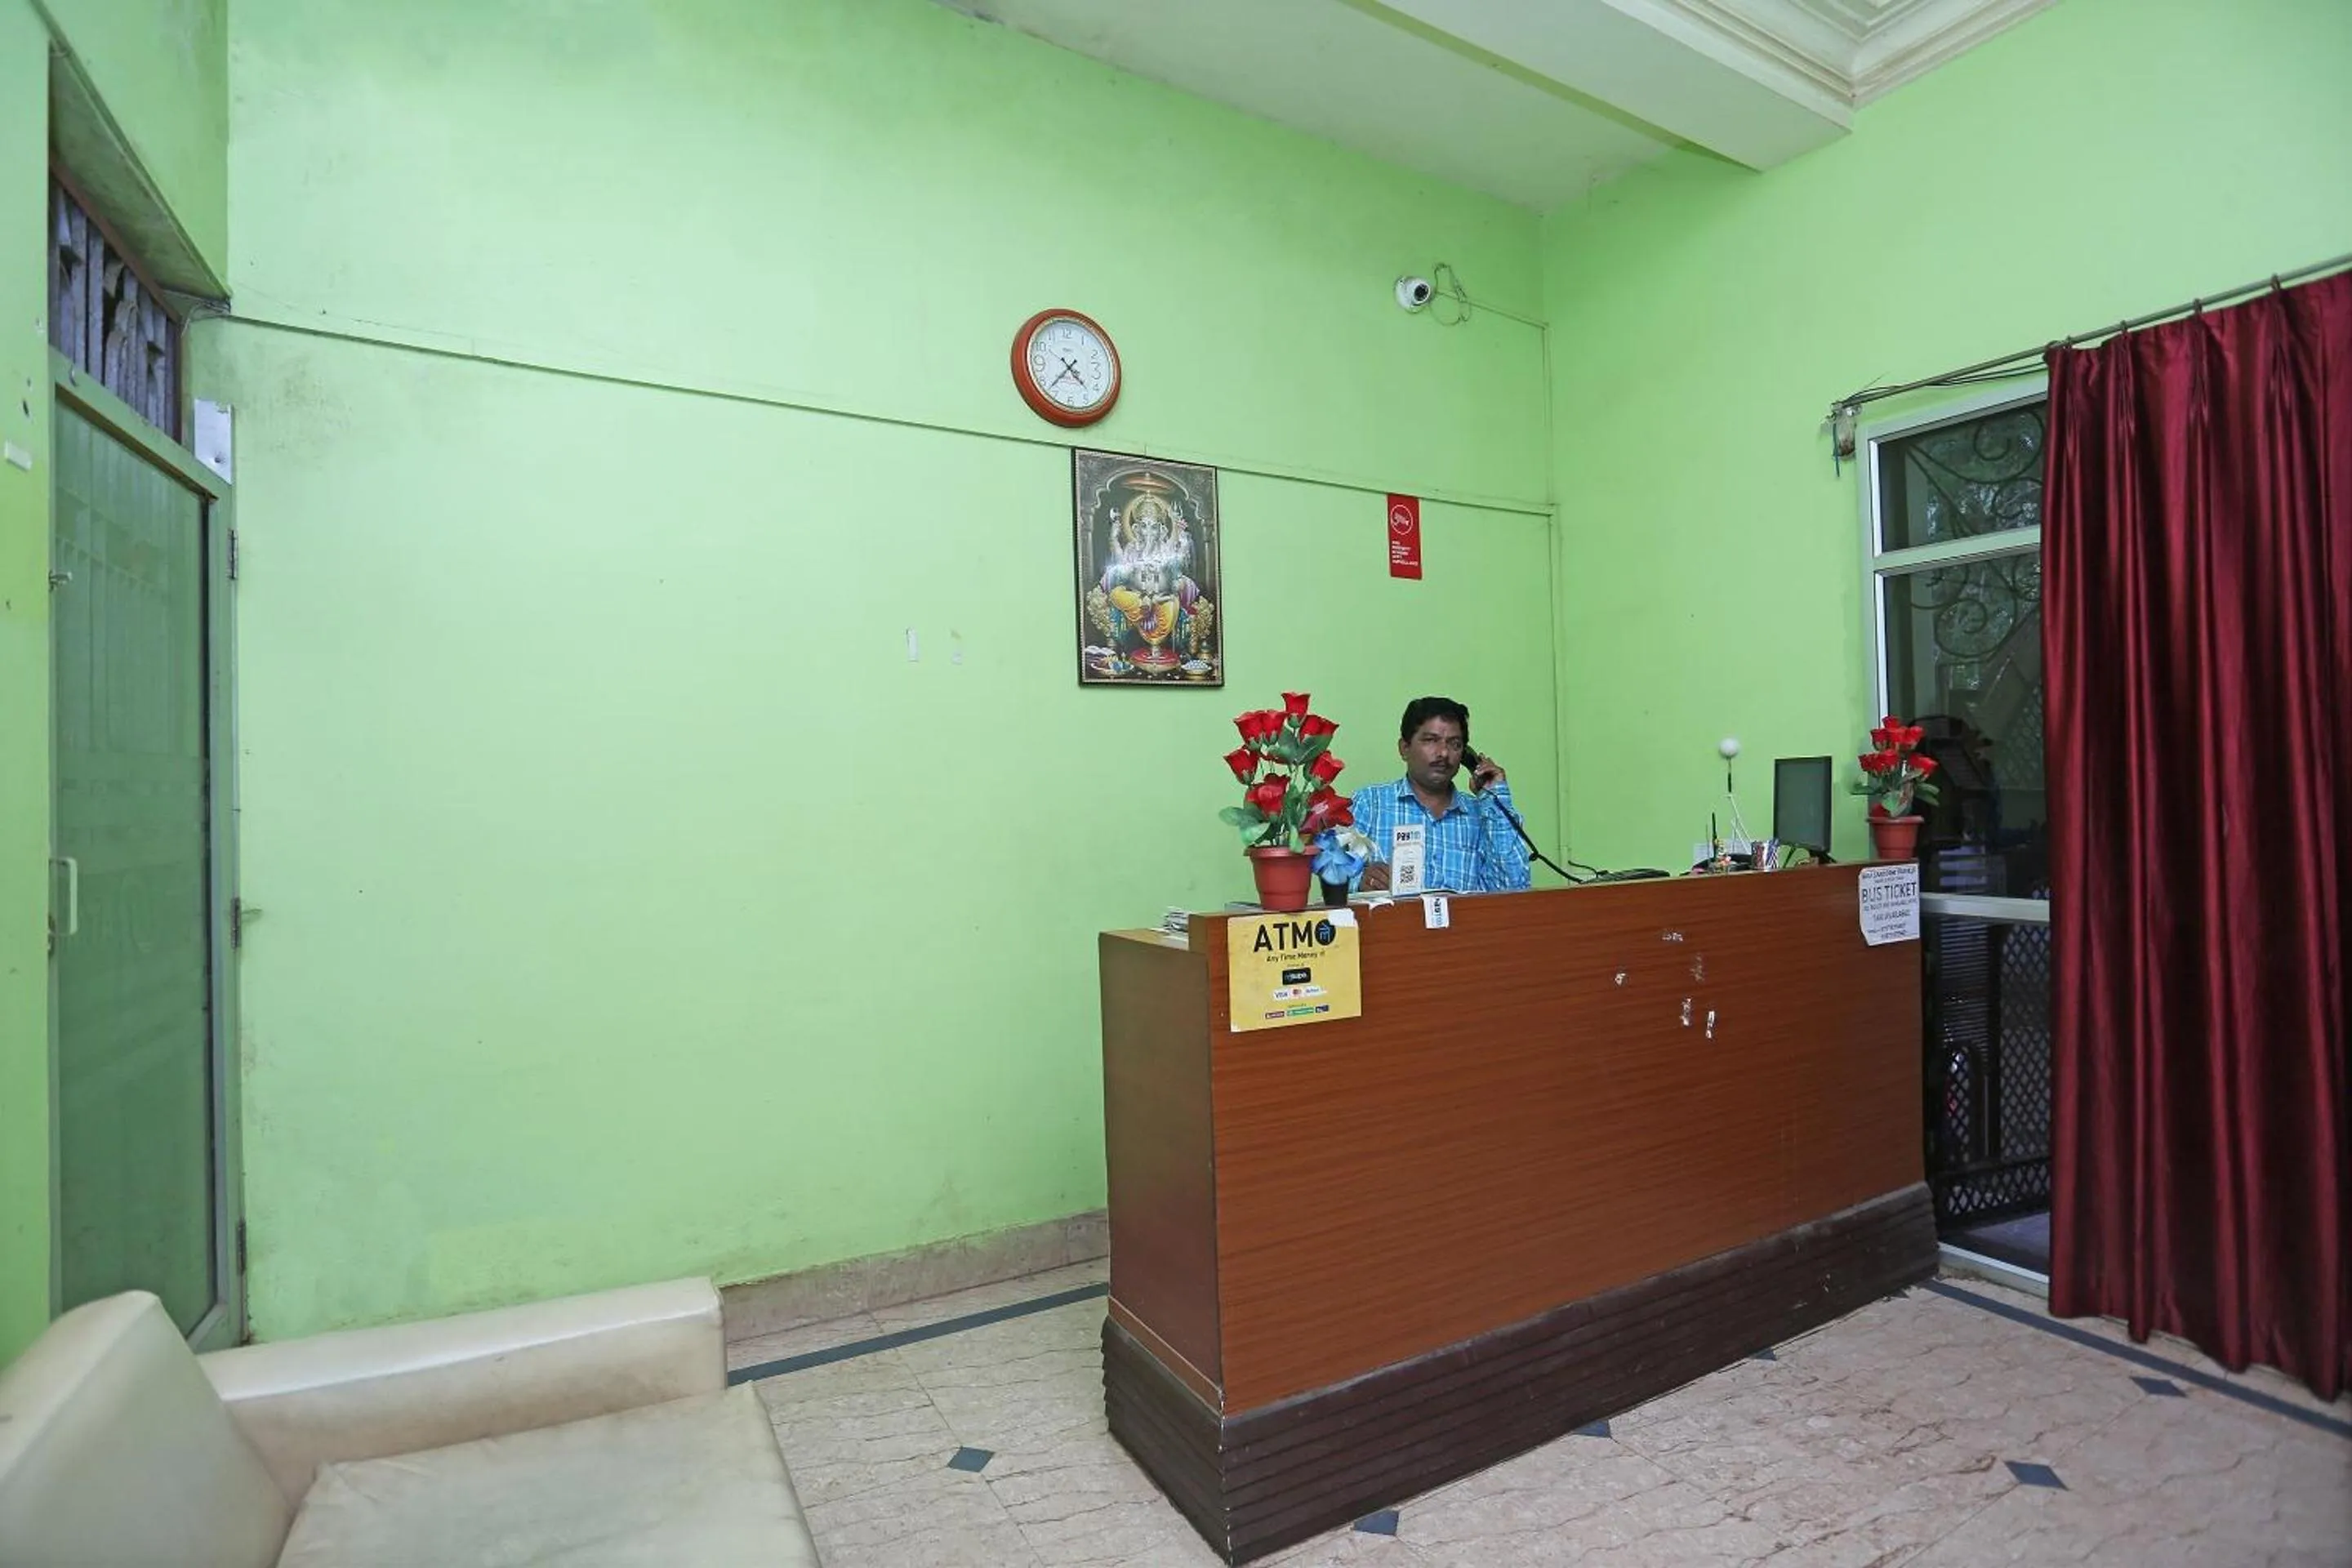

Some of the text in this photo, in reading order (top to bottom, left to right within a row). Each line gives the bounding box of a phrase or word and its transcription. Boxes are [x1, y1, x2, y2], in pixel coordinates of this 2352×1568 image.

[1061, 327, 1071, 339] 12
[1036, 341, 1046, 351] 10
[1090, 349, 1098, 359] 2
[1033, 354, 1045, 372] 9
[1090, 362, 1102, 380] 3
[1862, 882, 1917, 903] BUS TICKET
[1254, 920, 1313, 952] ATM
